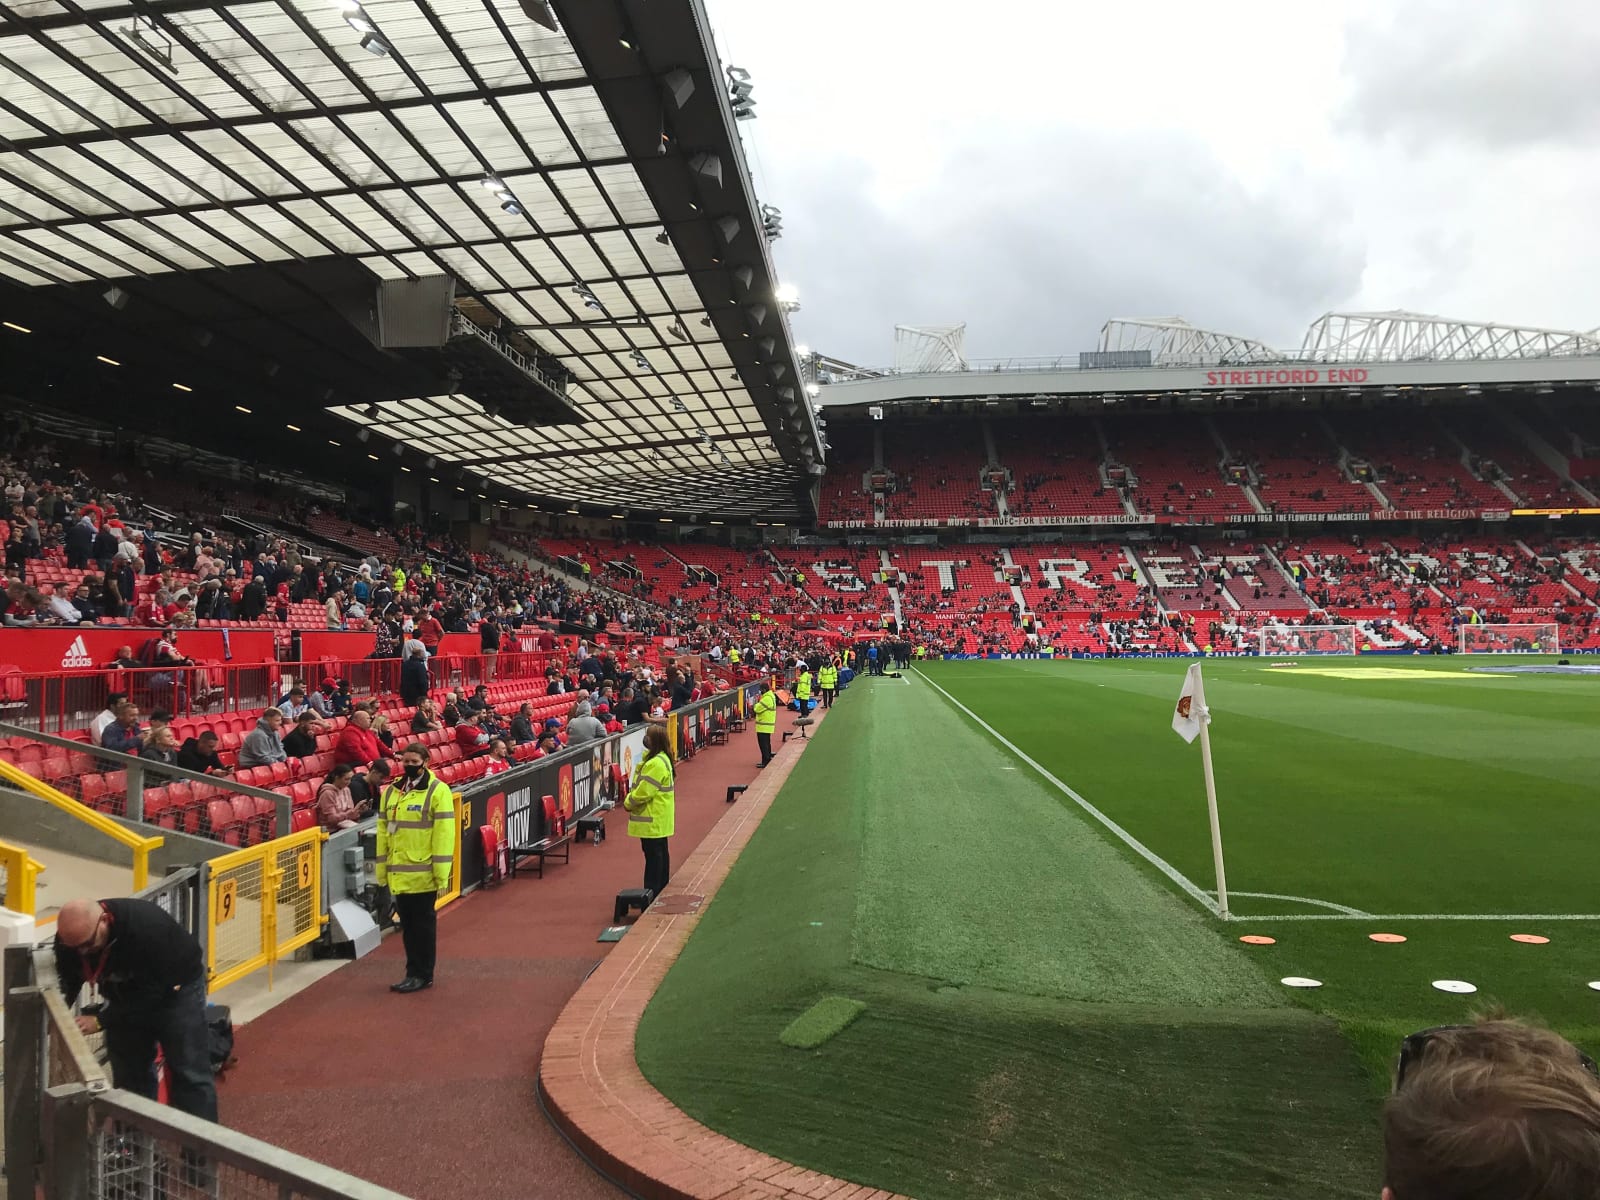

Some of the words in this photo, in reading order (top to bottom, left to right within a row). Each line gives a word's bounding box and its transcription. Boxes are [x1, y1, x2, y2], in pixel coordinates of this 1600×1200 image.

[1207, 369, 1319, 385] STRETFORD
[1327, 368, 1368, 383] END
[1101, 515, 1140, 523] RELIGION
[1288, 513, 1317, 521] FLOWERS
[1327, 512, 1370, 521] MANCHESTER
[1374, 510, 1400, 520] MUFC
[1403, 510, 1423, 519] THE
[1427, 509, 1476, 519] RELIGION
[828, 521, 844, 529] ONE
[845, 520, 866, 528] LOVE
[874, 519, 921, 528] STRETFORD
[923, 518, 939, 527] END
[947, 518, 970, 526] MUFC
[61, 656, 92, 668] adidas
[574, 777, 590, 813] NOW
[507, 808, 530, 850] NOW
[302, 862, 309, 885] 9
[223, 893, 231, 919] 9
